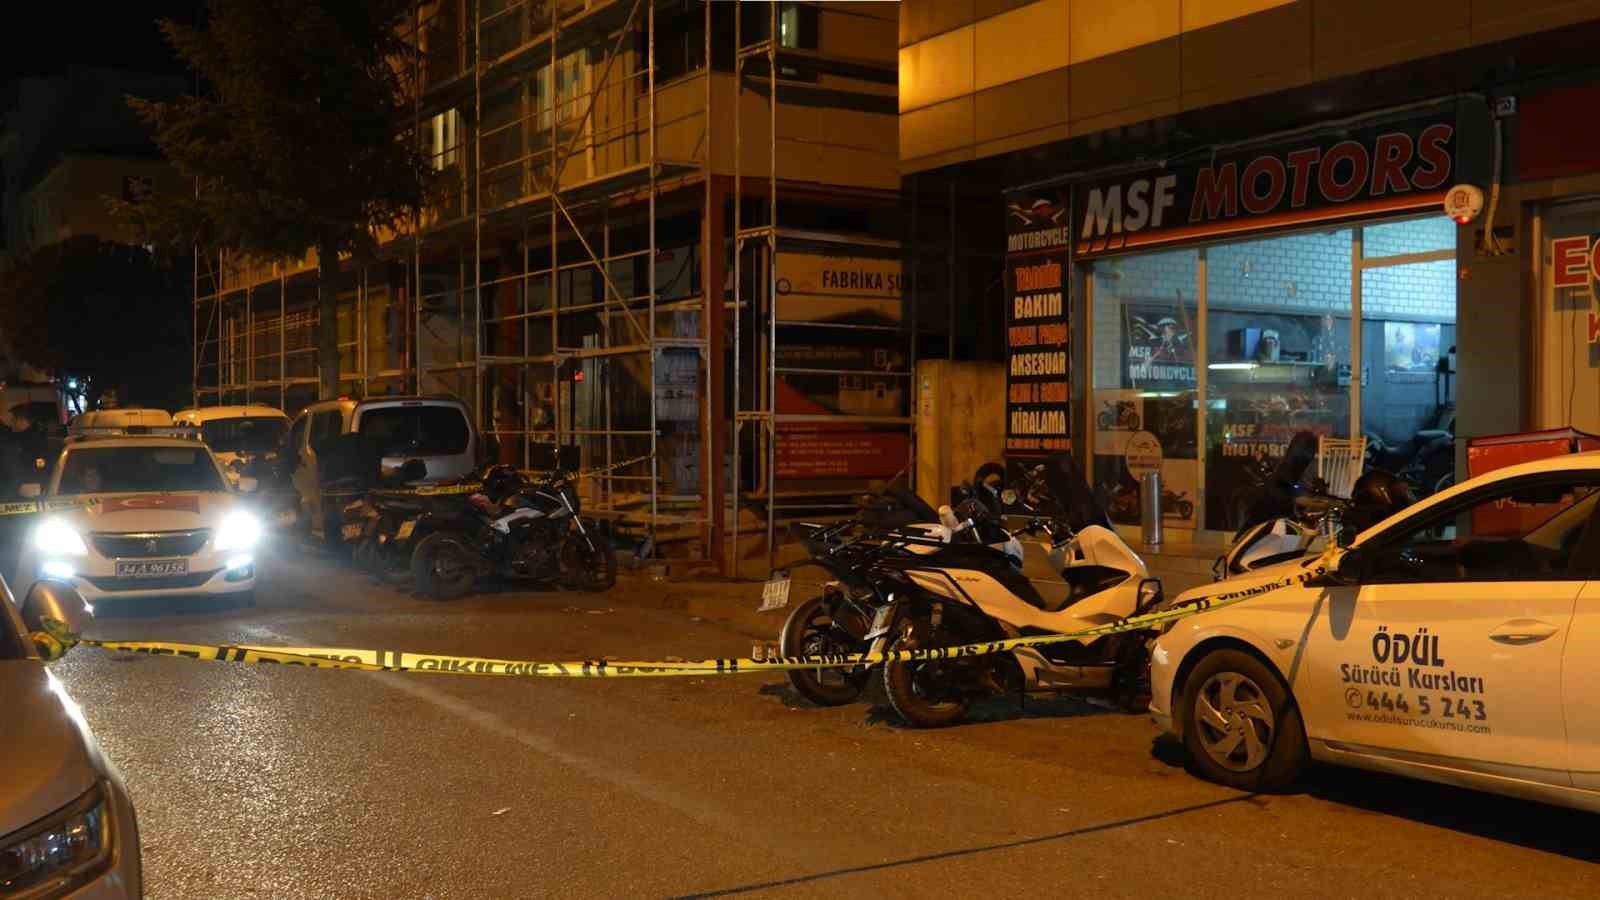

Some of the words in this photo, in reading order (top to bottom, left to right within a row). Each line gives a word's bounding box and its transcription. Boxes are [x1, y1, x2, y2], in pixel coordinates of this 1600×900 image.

[1081, 174, 1177, 240] MSF
[1191, 124, 1453, 222] MOTORS
[1007, 226, 1068, 251] MOTORCYCLE
[822, 267, 883, 290] FABRİKA
[1014, 292, 1062, 320] BAKIM
[1010, 352, 1066, 377] AKSESUAR
[1011, 407, 1066, 435] KİRALAMA
[1372, 626, 1445, 667] ÖDÜL
[1340, 664, 1401, 687] Sürücü
[1408, 667, 1484, 694] Kursları
[1366, 691, 1409, 713] 444
[1418, 695, 1430, 715] 5
[1440, 697, 1486, 720] 243
